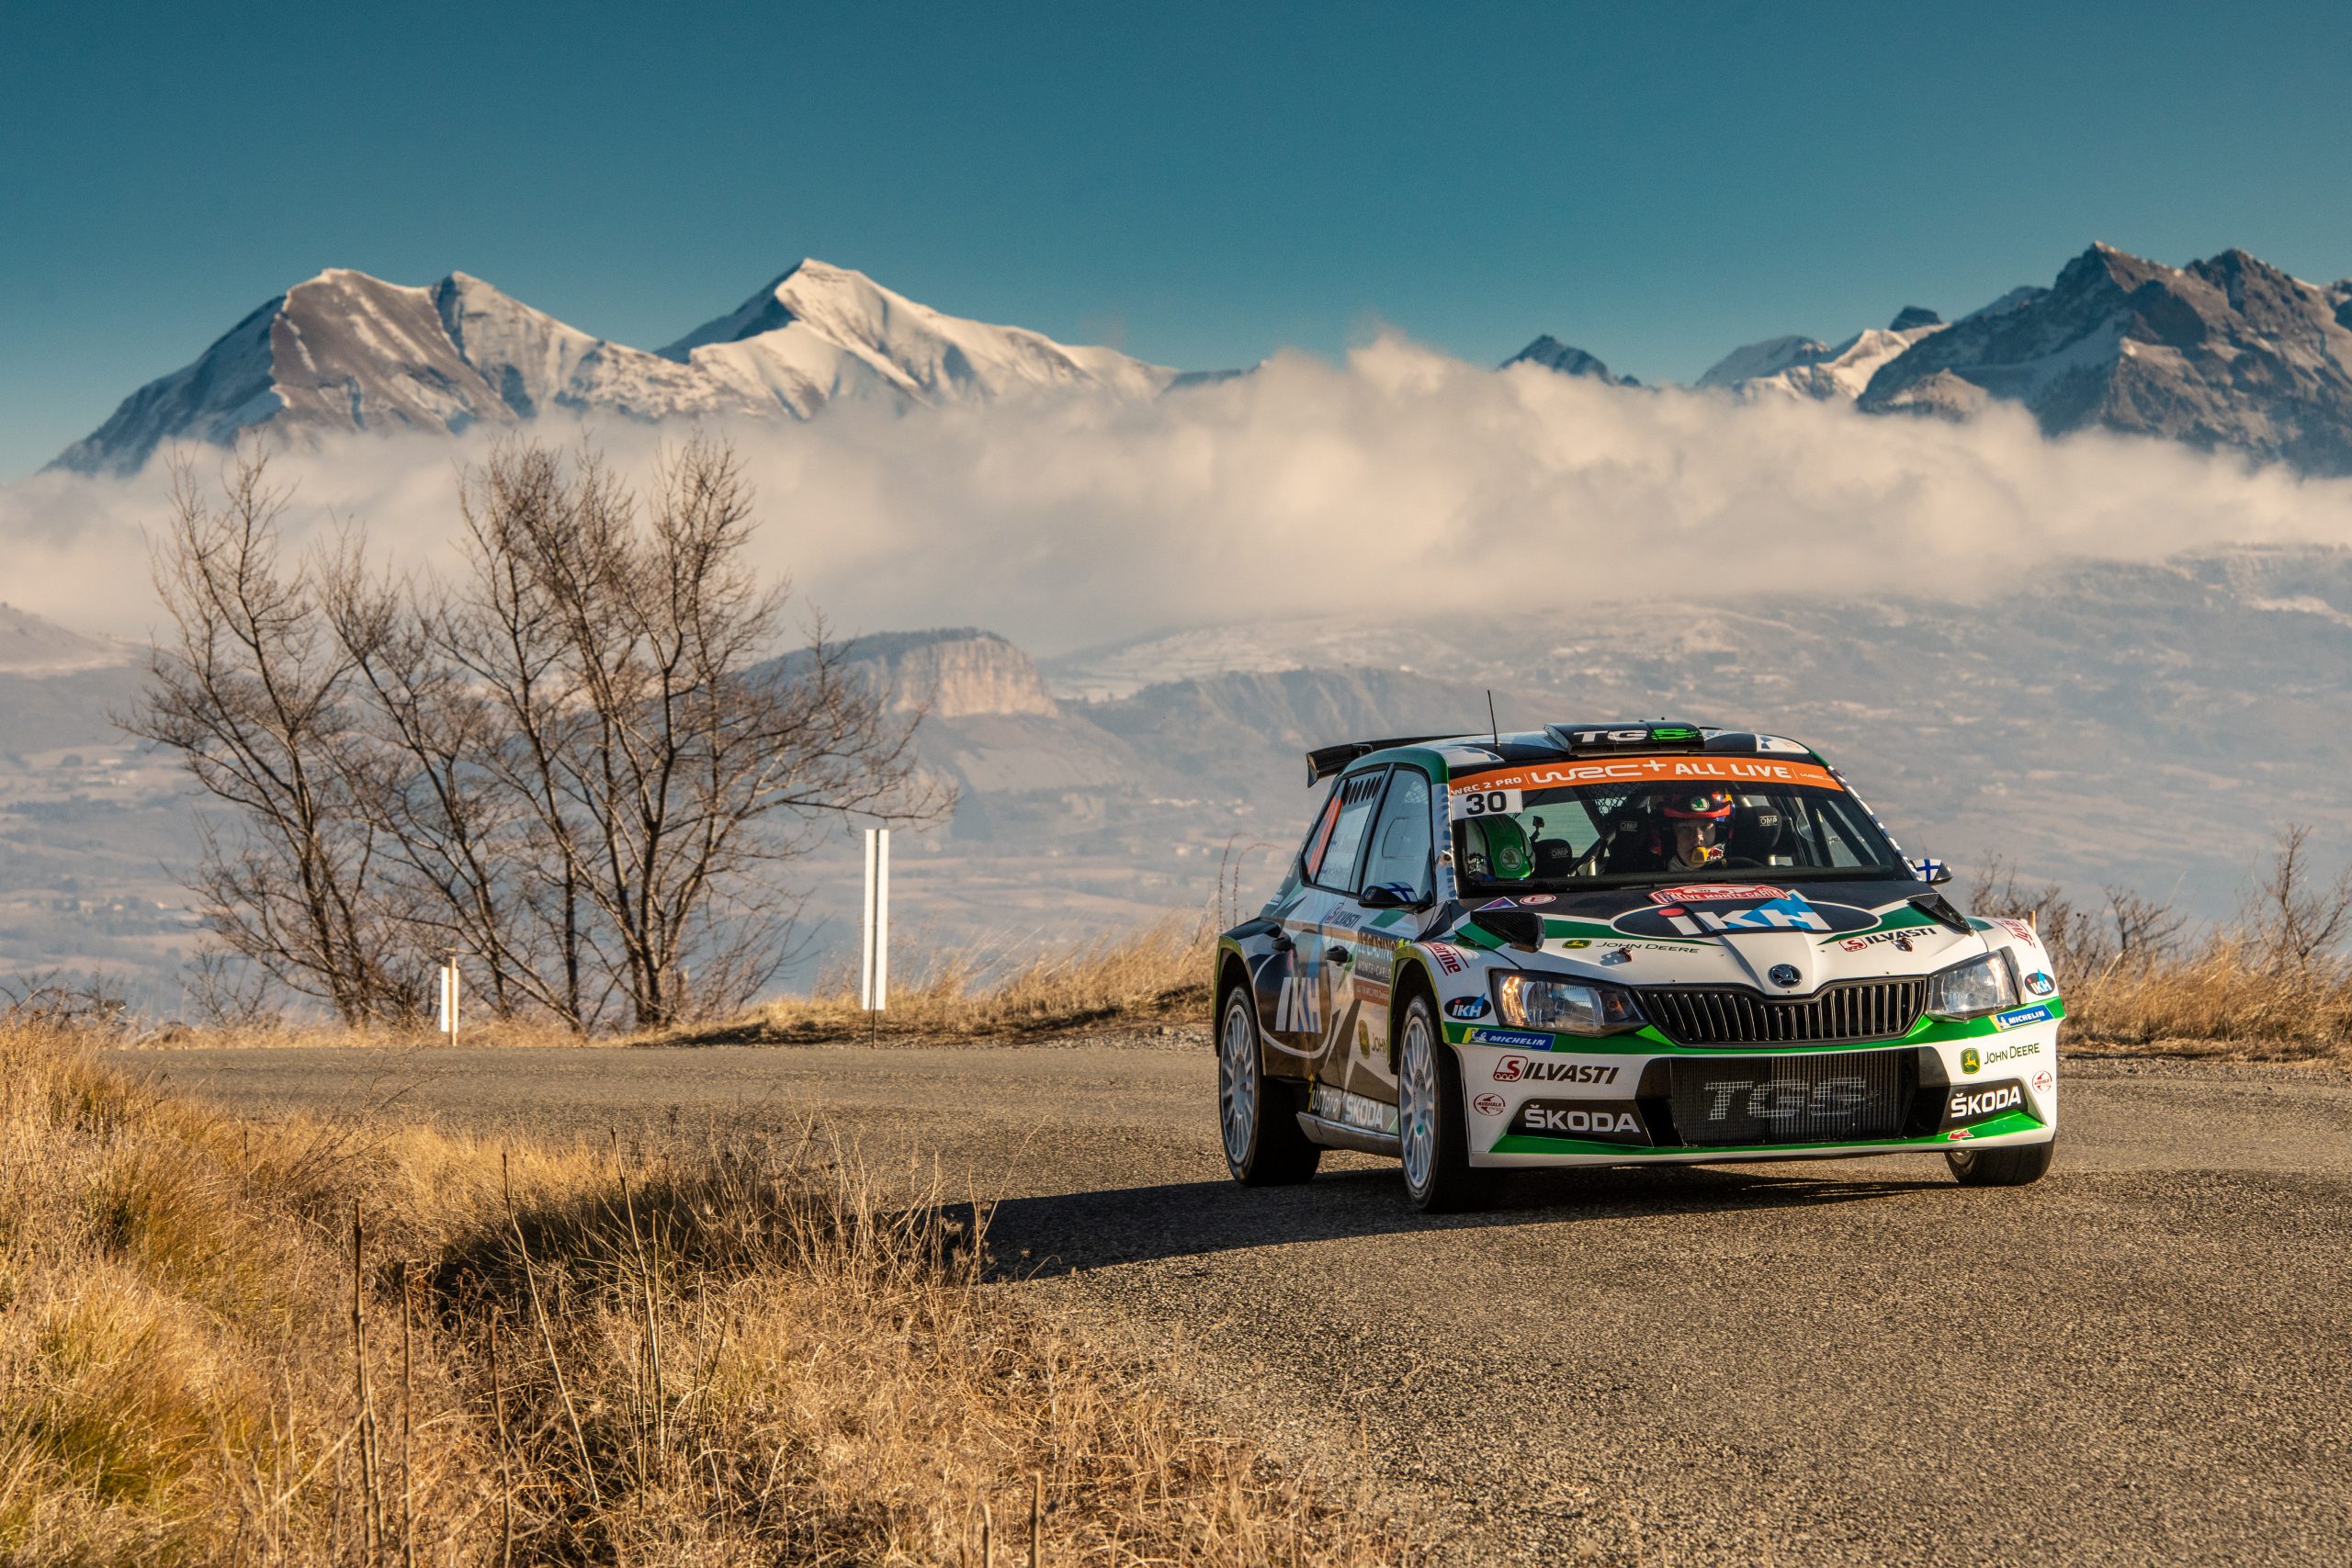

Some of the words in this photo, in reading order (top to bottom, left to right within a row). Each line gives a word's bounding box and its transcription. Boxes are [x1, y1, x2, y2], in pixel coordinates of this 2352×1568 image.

[1675, 763, 1725, 776] ALL
[1730, 763, 1792, 779] LIVE
[1451, 784, 1480, 796] WRC
[1496, 776, 1522, 787] PRO
[1465, 790, 1508, 816] 30
[1758, 816, 1778, 825] OMP
[1597, 942, 1642, 950] JOHN
[1645, 943, 1700, 953] DEERE
[1847, 928, 1937, 950] SILVASTI
[2008, 1010, 2045, 1025] MICHELIN
[1489, 1035, 1546, 1046] MICHELIN
[1984, 1049, 2008, 1065] JOHN
[2009, 1043, 2041, 1058] DEERE
[1507, 1059, 1620, 1085] SILVASTI
[1951, 1086, 2021, 1119] ŠKODA
[1525, 1104, 1641, 1134] ŠKODA
